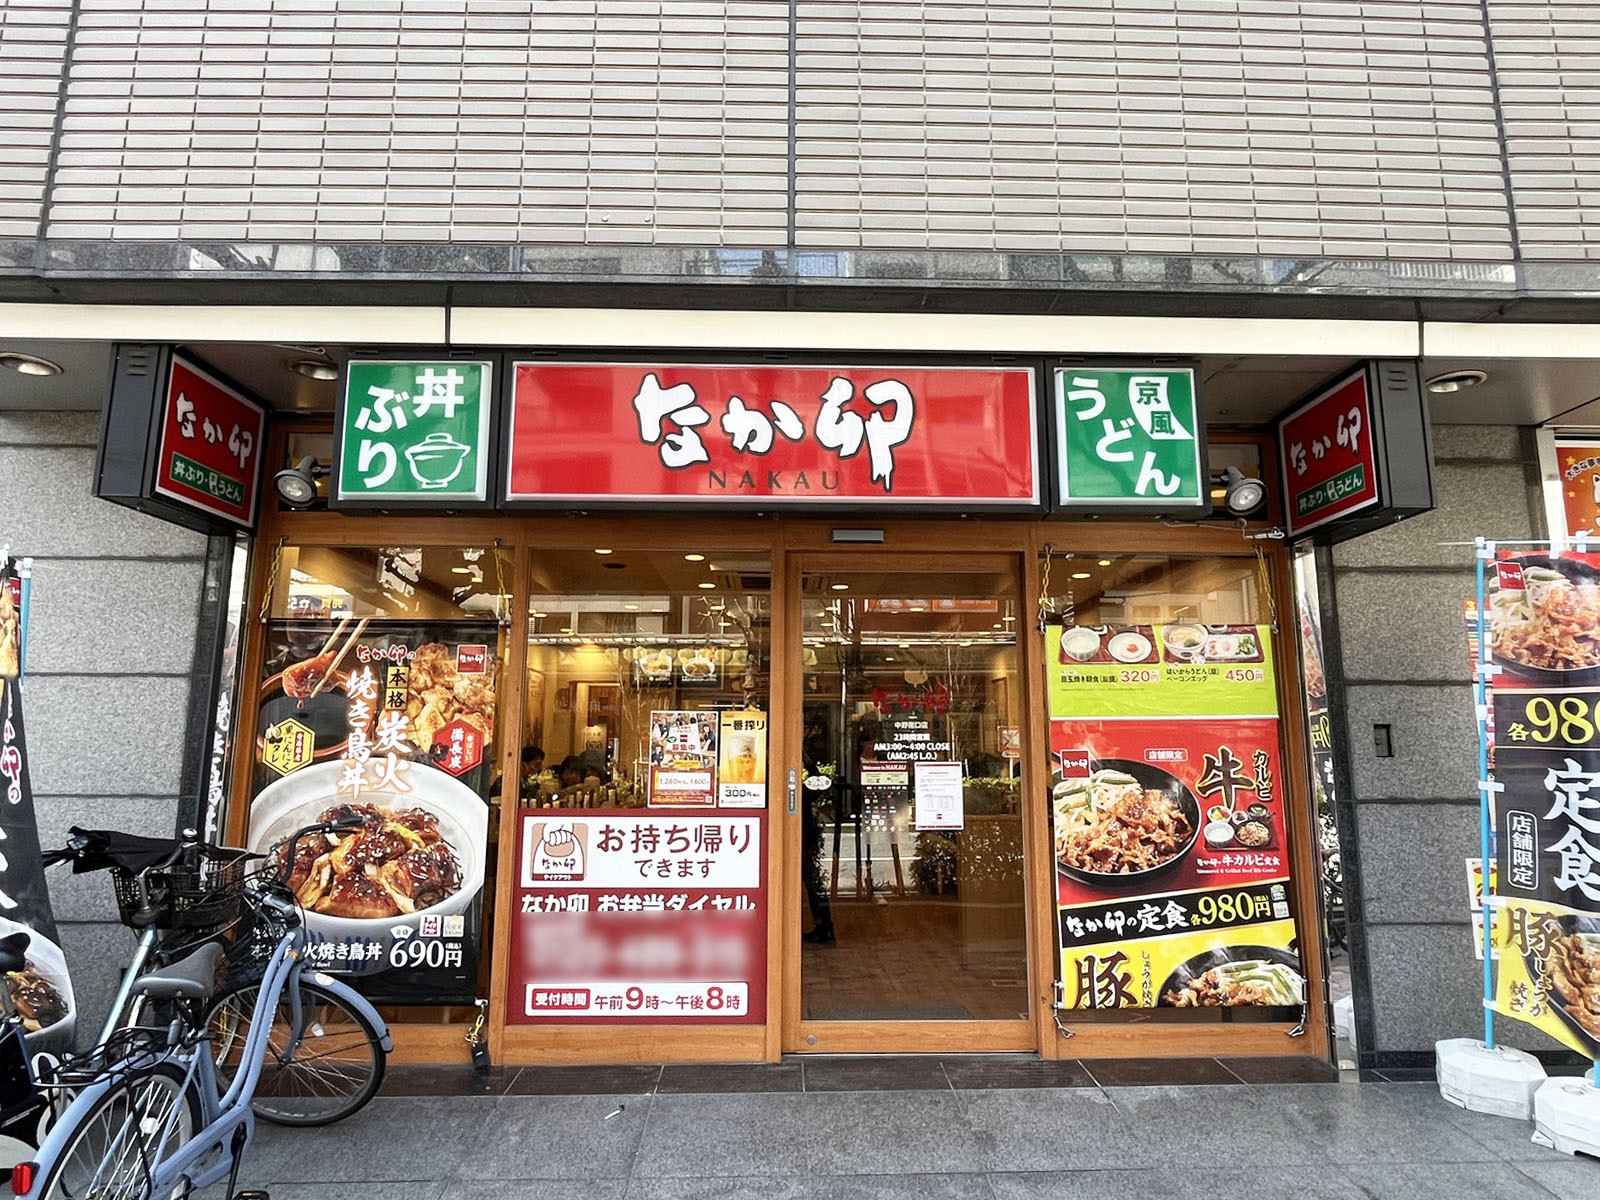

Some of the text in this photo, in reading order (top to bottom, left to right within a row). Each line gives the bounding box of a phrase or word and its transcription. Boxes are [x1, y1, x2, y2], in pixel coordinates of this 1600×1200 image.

[1134, 380, 1176, 434] 京風
[175, 392, 253, 470] なか卯
[632, 372, 915, 493] なか卯
[1066, 376, 1182, 497] うどん
[1290, 406, 1361, 476] なか卯
[708, 470, 841, 489] NAKAU
[356, 644, 416, 665] なか卯の
[459, 652, 484, 664] なか卯
[387, 668, 409, 709] 本格
[1121, 670, 1159, 682] 320円
[1225, 669, 1263, 682] 450円
[337, 665, 379, 799] 焼き鳥丼
[722, 719, 765, 730] 一番搾り
[1507, 697, 1600, 744] 各98
[372, 711, 412, 792] 炭火
[927, 743, 951, 751] CLOSE
[1148, 751, 1184, 761] 店舗限定
[1063, 758, 1088, 769] なか卯
[1195, 745, 1256, 813] 牛
[1253, 749, 1273, 802] カルビ
[597, 823, 751, 854] お持ち帰り
[1511, 815, 1534, 886] 店舗限定
[541, 858, 577, 871] なか卯
[543, 873, 573, 881] テイクアウト
[634, 859, 716, 878] できます
[521, 893, 590, 912] なか卯
[1066, 899, 1191, 937] なか卯の定食
[1505, 907, 1566, 961] 豚
[389, 940, 463, 968] 690円
[1074, 949, 1138, 1009] 豚
[535, 991, 587, 1007] 受付時間
